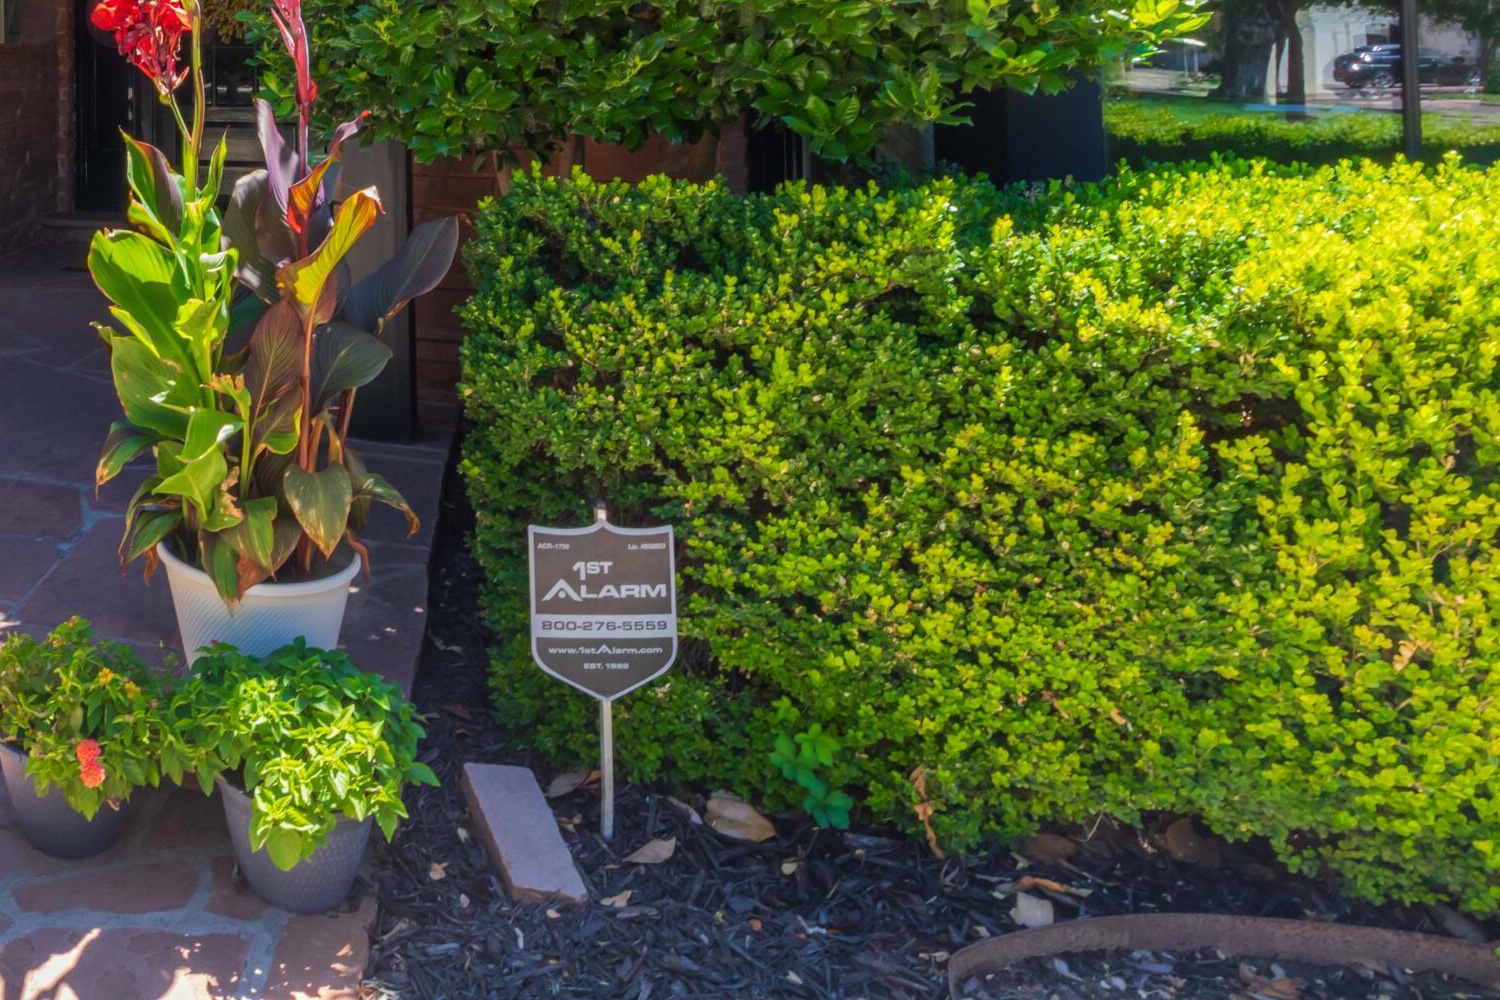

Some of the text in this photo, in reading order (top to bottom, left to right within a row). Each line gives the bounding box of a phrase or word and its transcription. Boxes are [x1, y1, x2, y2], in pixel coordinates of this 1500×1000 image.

[572, 561, 613, 581] 1ST
[541, 578, 667, 602] ALARM
[541, 620, 668, 632] 800-276-5559
[548, 644, 663, 655] www.1stAlarm.com
